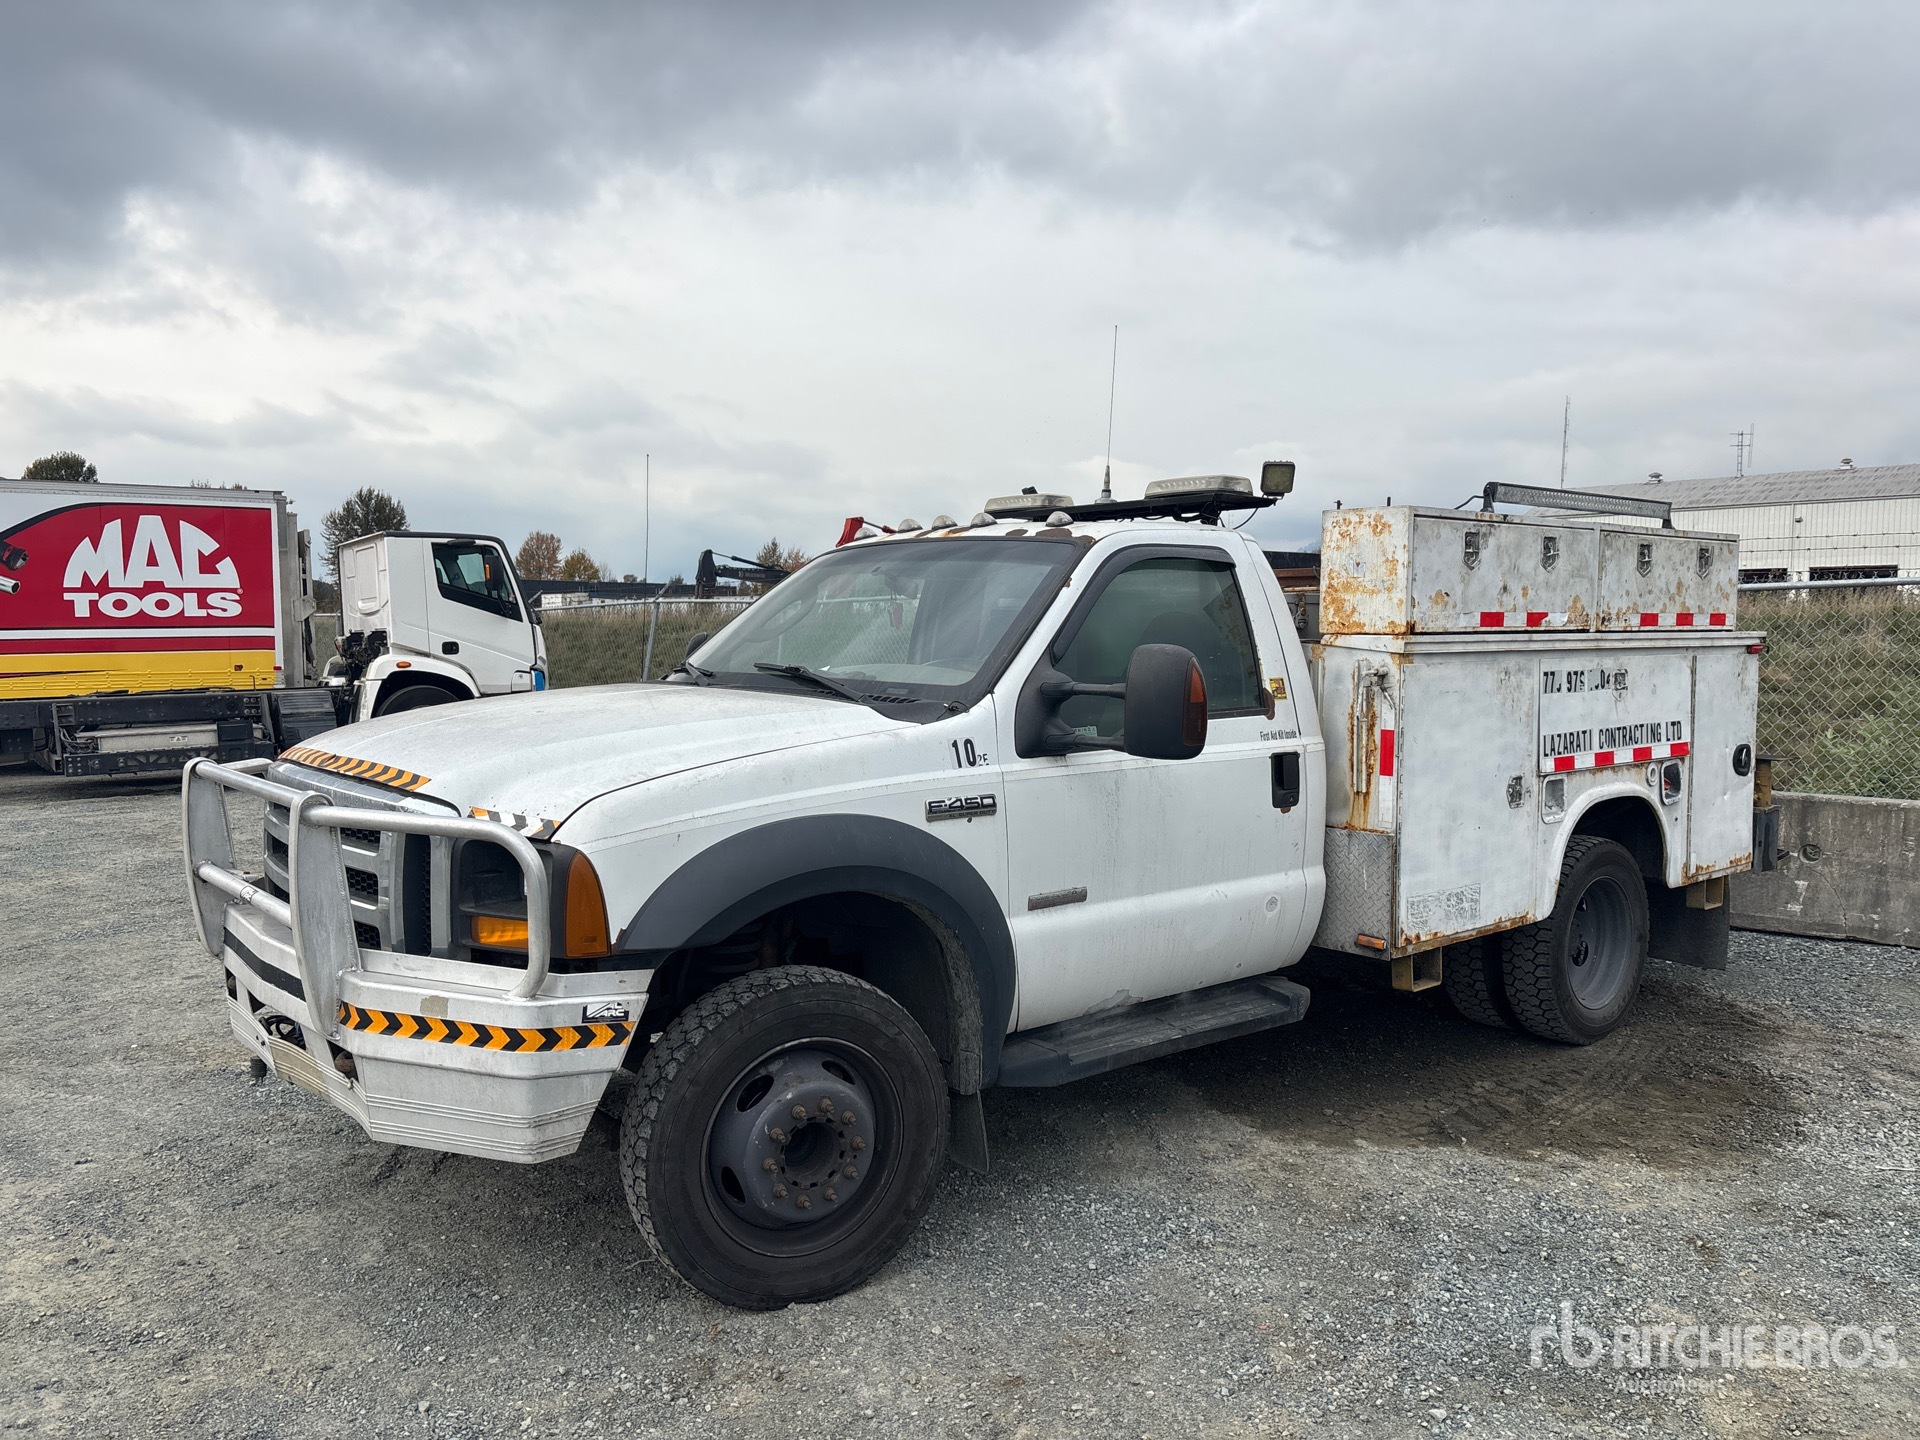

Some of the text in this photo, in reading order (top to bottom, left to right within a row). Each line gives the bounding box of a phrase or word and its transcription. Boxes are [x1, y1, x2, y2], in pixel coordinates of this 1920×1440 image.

[63, 514, 240, 588] MAC
[63, 591, 242, 618] TOOLS
[1260, 730, 1270, 741] First
[1270, 729, 1278, 741] Aid
[1543, 720, 1681, 757] LAZARATI CONTRACTING LTD
[951, 738, 977, 768] 10
